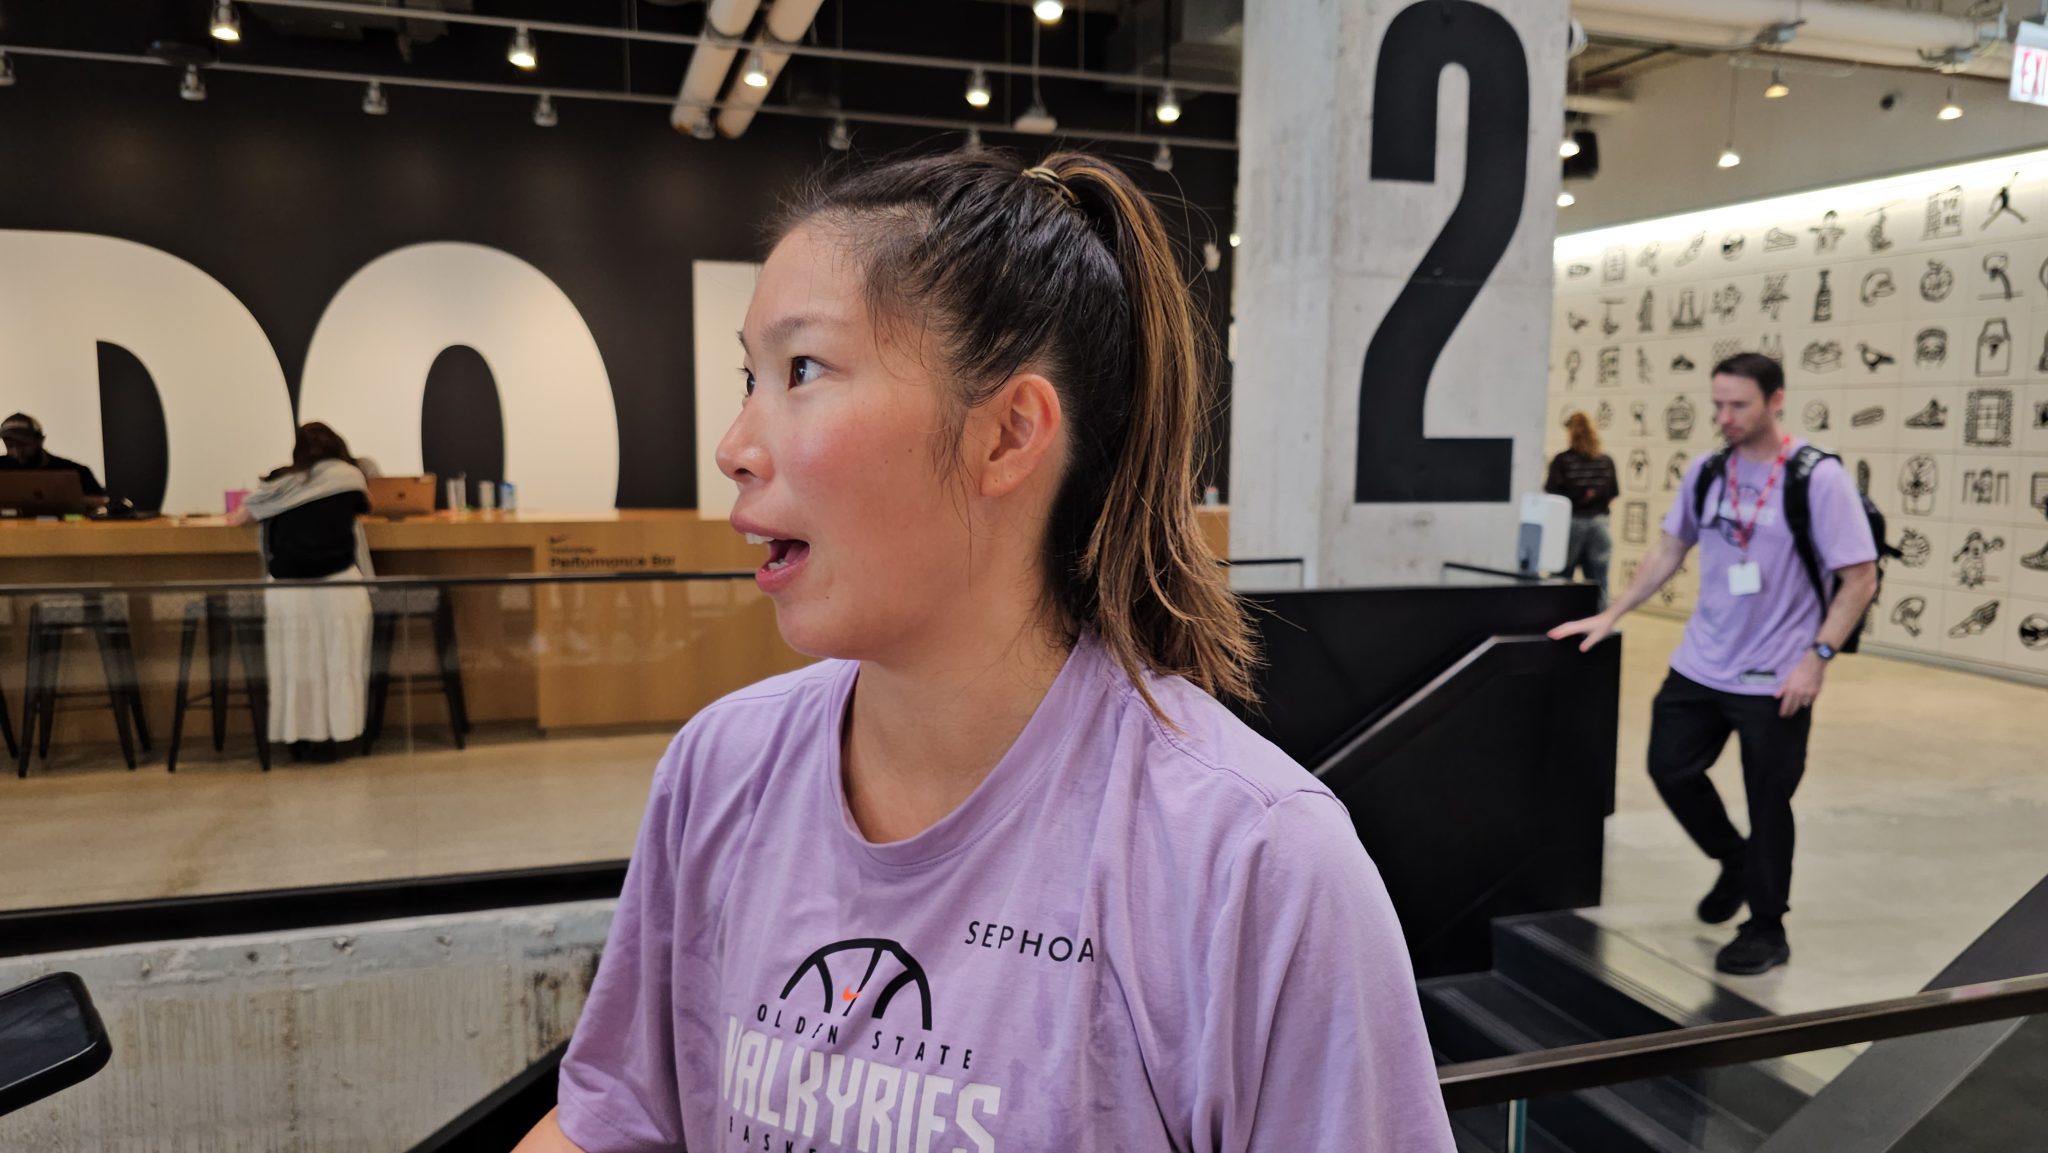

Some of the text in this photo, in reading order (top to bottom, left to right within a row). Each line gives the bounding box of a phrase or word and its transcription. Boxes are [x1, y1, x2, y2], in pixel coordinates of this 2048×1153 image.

[1355, 0, 1529, 503] 2
[549, 554, 676, 568] Performance Bar
[964, 920, 1095, 963] SEPHOA
[872, 1030, 973, 1070] STATE
[722, 1015, 1001, 1153] VALKYRIES
